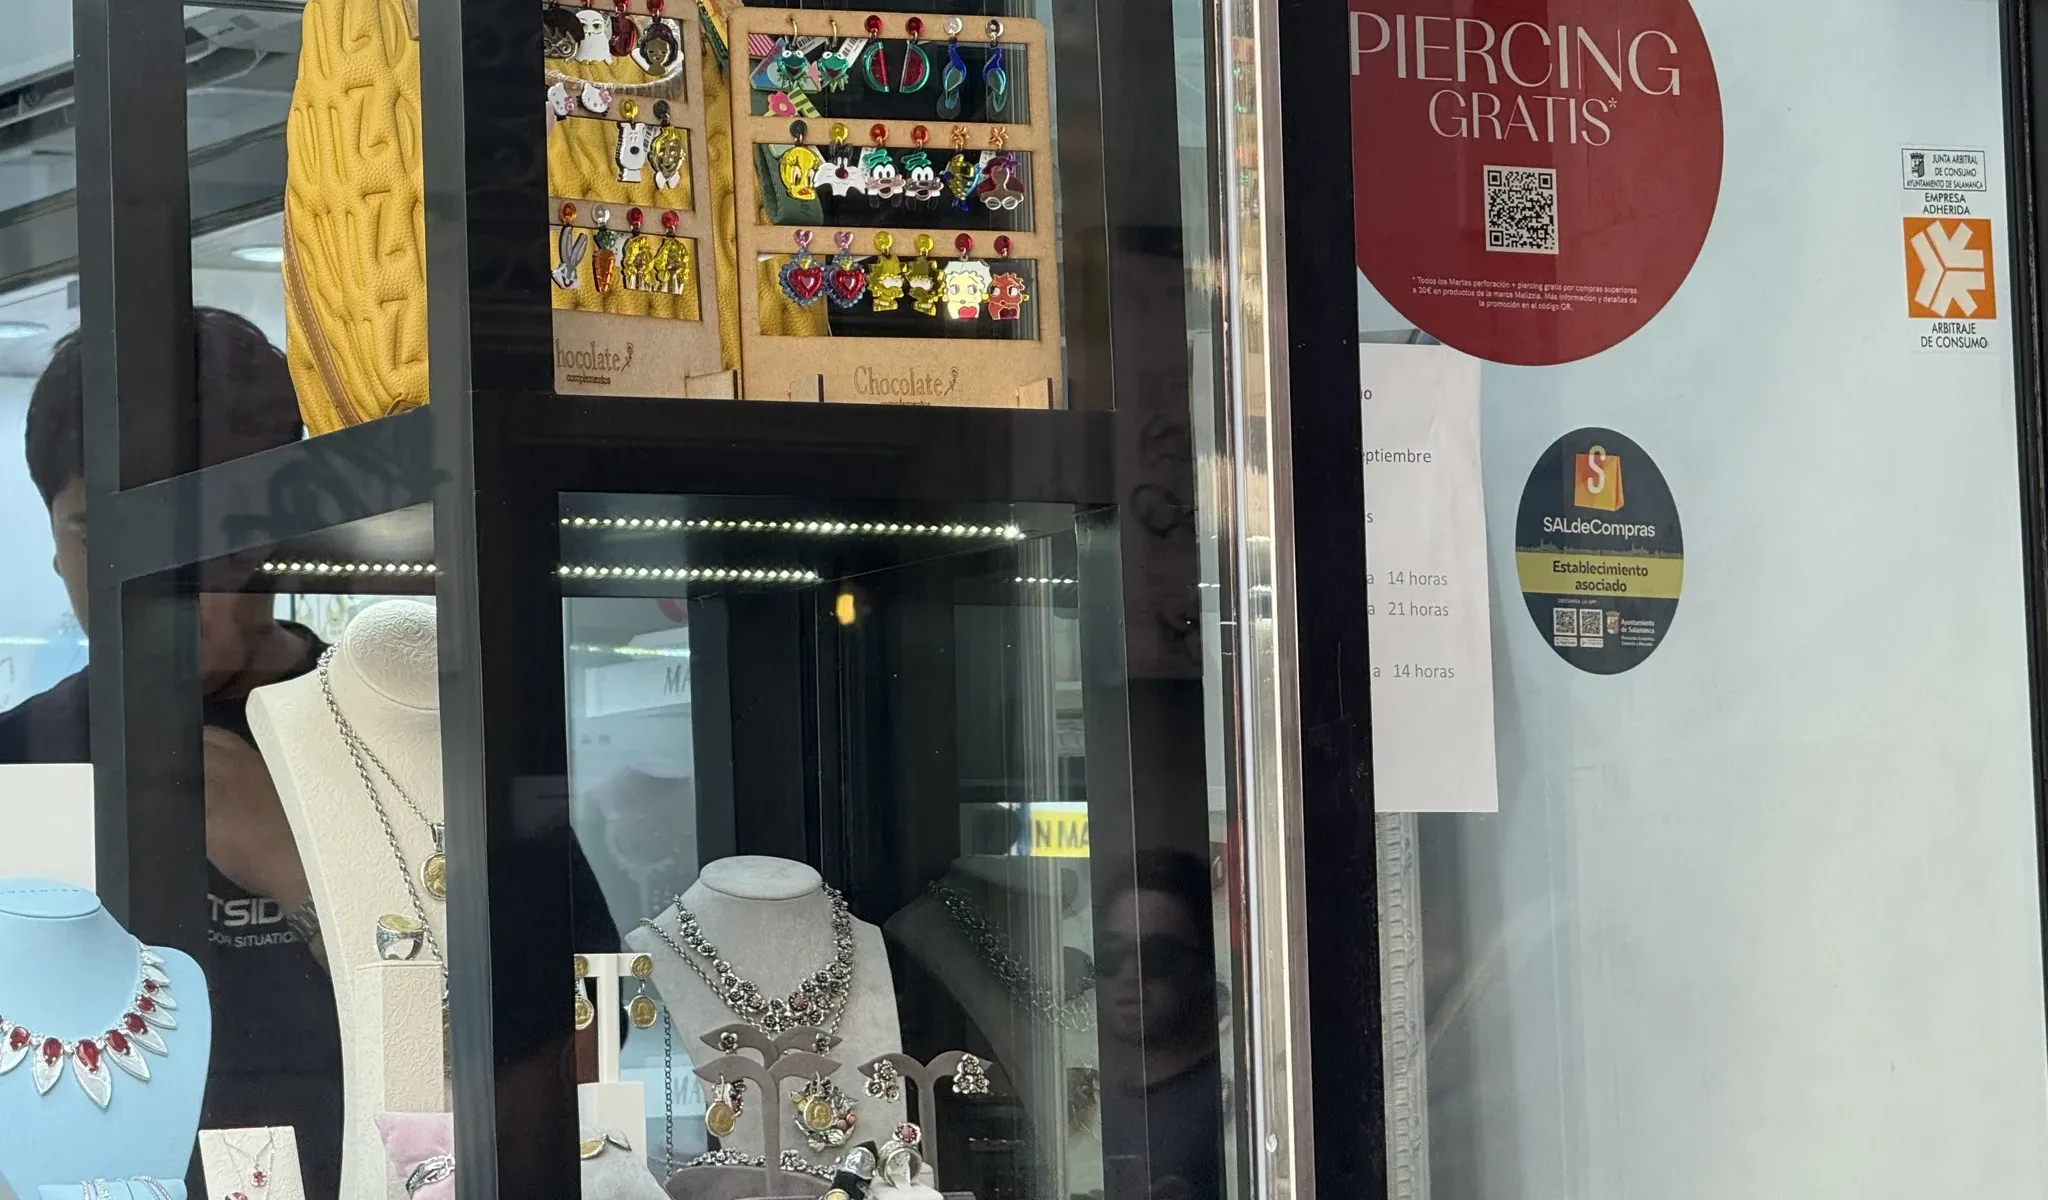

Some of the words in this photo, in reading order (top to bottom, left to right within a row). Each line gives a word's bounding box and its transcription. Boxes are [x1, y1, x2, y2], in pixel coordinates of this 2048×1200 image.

[1350, 11, 1680, 96] PIERCING
[1932, 154, 1950, 164] JUNTA
[1952, 154, 1978, 165] ARBITRAL
[1935, 168, 1943, 176] DE
[1944, 168, 1977, 177] CONSUMO
[1906, 180, 1944, 188] AYUNTAMIENTO
[1953, 181, 1984, 189] SALAMANCA
[1925, 192, 1967, 203] EMPRESA
[1923, 205, 1971, 215] ADHERIDA
[1417, 276, 1437, 285] Todos
[1438, 277, 1448, 285] los
[1449, 278, 1472, 287] Martes
[1473, 279, 1510, 289] perforación
[1518, 281, 1543, 291] piercing
[1544, 283, 1562, 292] gratis
[1576, 285, 1603, 293] compras
[1604, 286, 1638, 295] superiores
[1419, 286, 1432, 295] 30€
[1443, 289, 1475, 297] productos
[1476, 289, 1485, 297] de
[1544, 292, 1558, 300] Más
[1559, 292, 1597, 302] información
[1603, 294, 1628, 304] detalles
[1629, 296, 1638, 304] de
[1479, 299, 1485, 307] la
[1486, 301, 1520, 309] promoción
[1531, 301, 1538, 309] el
[1932, 322, 1976, 335] ARBITRAJE
[1921, 335, 1933, 348] DE
[1936, 335, 1988, 349] CONSUMO
[854, 365, 943, 397] Chocolate
[1543, 516, 1656, 540] SALdeCompras
[1553, 560, 1649, 577] Establecimiento
[1367, 573, 1374, 585] a
[1388, 571, 1404, 585] 14
[1408, 571, 1448, 586] horas
[1575, 577, 1628, 593] asociado
[1368, 604, 1376, 616] a
[1388, 602, 1405, 616] 21
[1410, 602, 1449, 616] horas
[1373, 666, 1381, 678] a
[1393, 663, 1410, 678] 14
[1415, 663, 1455, 679] horas
[234, 930, 297, 948] SITUATIO
